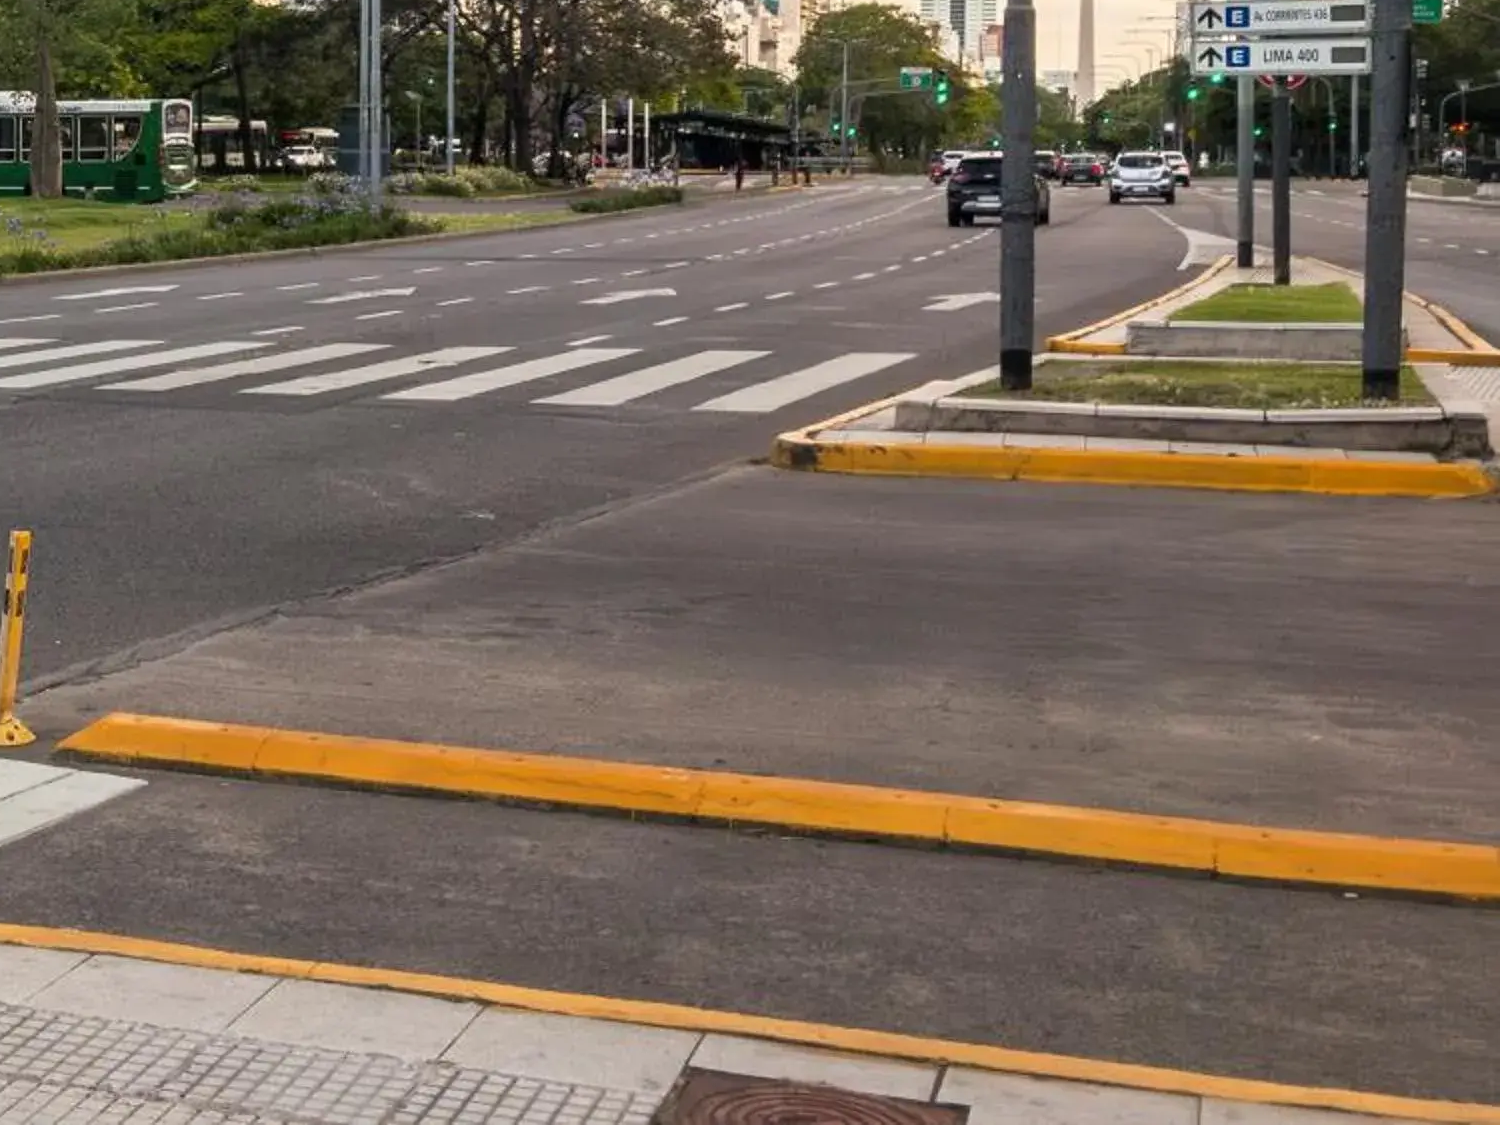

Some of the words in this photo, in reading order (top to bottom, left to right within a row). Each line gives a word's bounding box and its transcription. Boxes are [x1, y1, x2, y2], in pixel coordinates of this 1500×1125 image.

[1266, 9, 1312, 21] CORRIENTES
[1263, 49, 1293, 63] LIMA
[1297, 49, 1319, 63] 400
